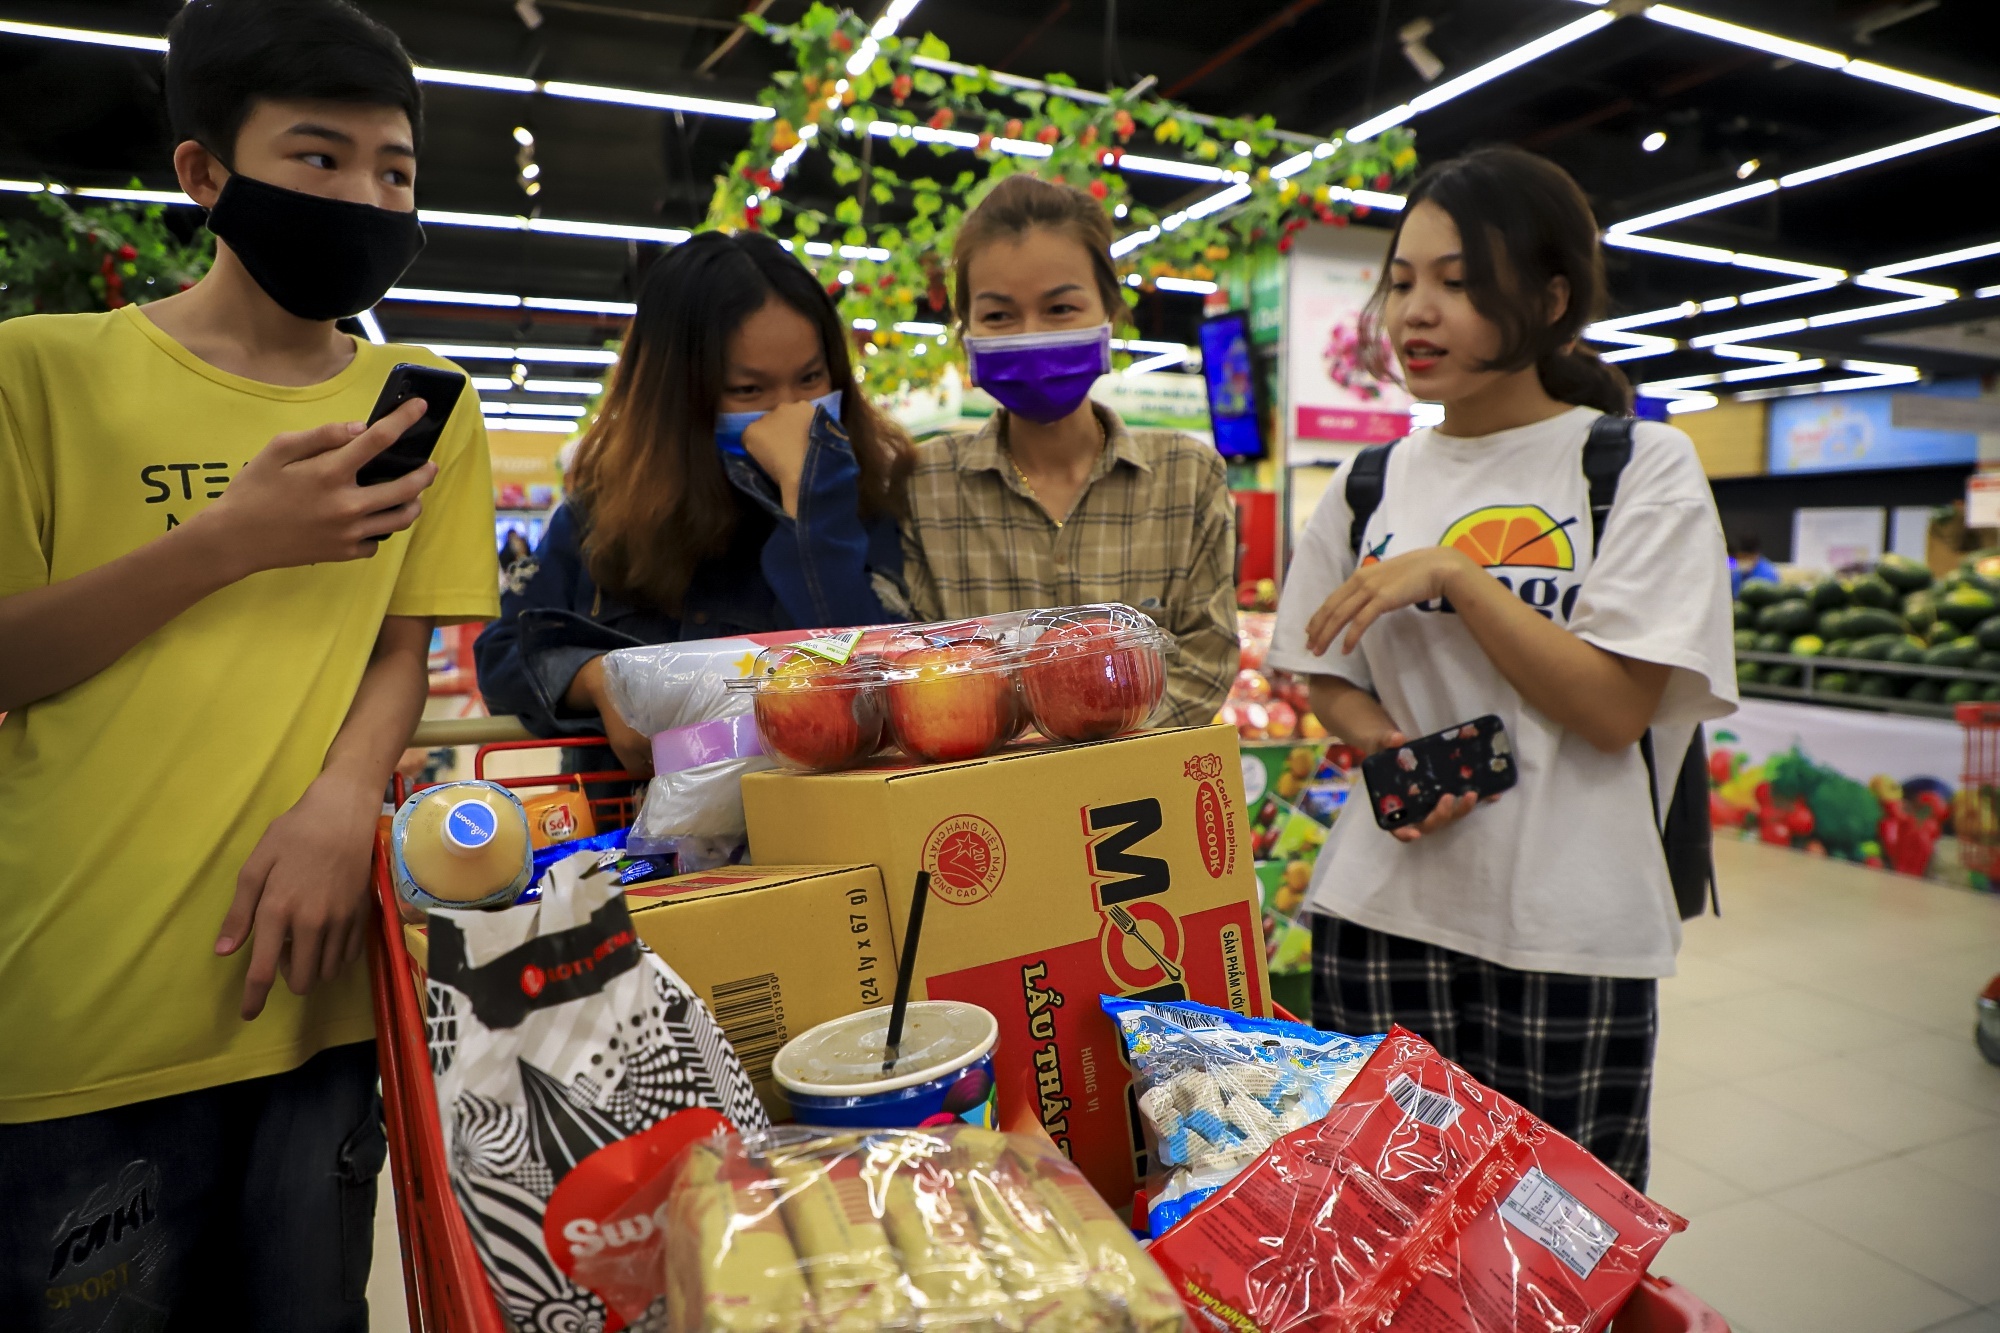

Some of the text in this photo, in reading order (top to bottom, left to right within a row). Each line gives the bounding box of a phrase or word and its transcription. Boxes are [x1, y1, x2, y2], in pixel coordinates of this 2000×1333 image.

[140, 461, 249, 504] STE
[454, 810, 489, 839] woongjin
[1215, 778, 1237, 876] Cook happiness
[972, 847, 988, 873] 2019
[985, 856, 1001, 884] NAM
[956, 887, 978, 898] CAO
[845, 888, 884, 1005] (24 ly x 67 g)
[1222, 930, 1240, 954] SẢN
[1226, 955, 1246, 988] PHẨM
[769, 975, 785, 1022] 031930
[1021, 960, 1064, 1040] LẨU
[1230, 989, 1246, 1009] VỚI
[1034, 1046, 1072, 1135] THÁI
[1089, 1097, 1100, 1114] VỊ
[45, 1262, 130, 1310] SPORT
